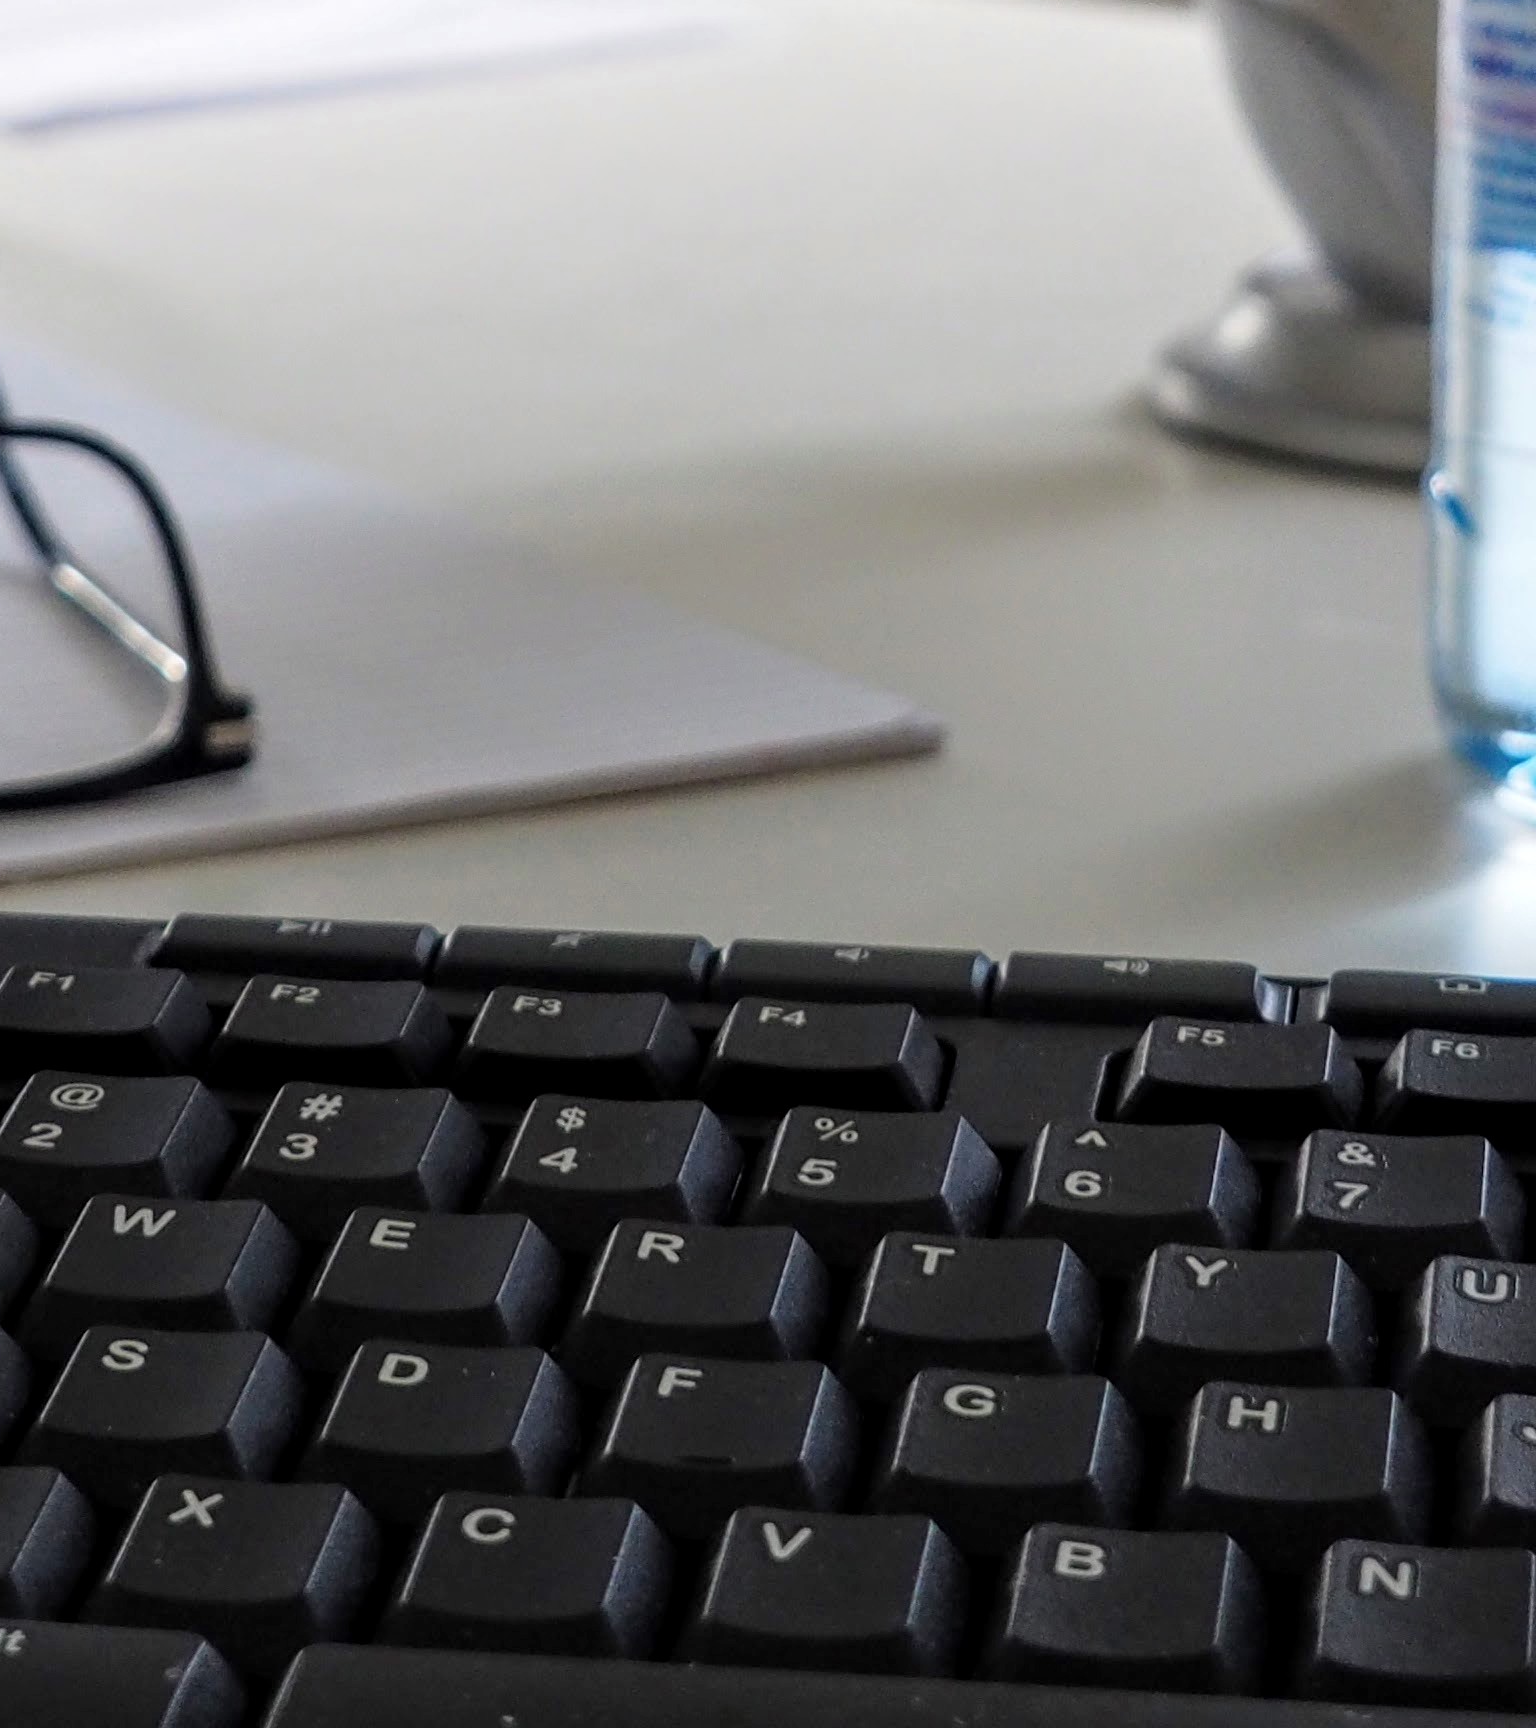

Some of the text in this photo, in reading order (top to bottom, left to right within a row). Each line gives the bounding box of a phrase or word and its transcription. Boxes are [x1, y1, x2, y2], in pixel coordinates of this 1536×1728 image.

[28, 972, 75, 993] F1
[270, 983, 321, 1004] F2
[512, 995, 563, 1016] F3
[759, 1007, 807, 1028] F4
[1176, 1026, 1227, 1046] F5
[1431, 1039, 1481, 1060] F6
[49, 1083, 106, 1112] @
[299, 1092, 344, 1121] #
[555, 1105, 587, 1132] $
[814, 1116, 859, 1143] %
[23, 1124, 63, 1148] 2
[279, 1133, 318, 1160] 3
[1074, 1129, 1109, 1148] ^
[539, 1147, 579, 1174] 4
[1336, 1140, 1377, 1169] &
[797, 1158, 839, 1186] 5
[1064, 1171, 1102, 1199] 6
[1332, 1183, 1368, 1210] 7
[112, 1205, 176, 1237] W
[370, 1219, 418, 1251] E
[637, 1231, 685, 1264] R
[911, 1244, 956, 1274] T
[1184, 1257, 1229, 1287] Y
[1462, 1270, 1508, 1301] U
[101, 1340, 150, 1371] S
[378, 1353, 429, 1386] D
[658, 1368, 703, 1397] F
[944, 1384, 997, 1417] G
[1228, 1398, 1278, 1431] H
[169, 1490, 225, 1527] X
[462, 1509, 515, 1544] C
[763, 1523, 812, 1560] V
[1054, 1542, 1107, 1577] B
[1361, 1558, 1411, 1597] N
